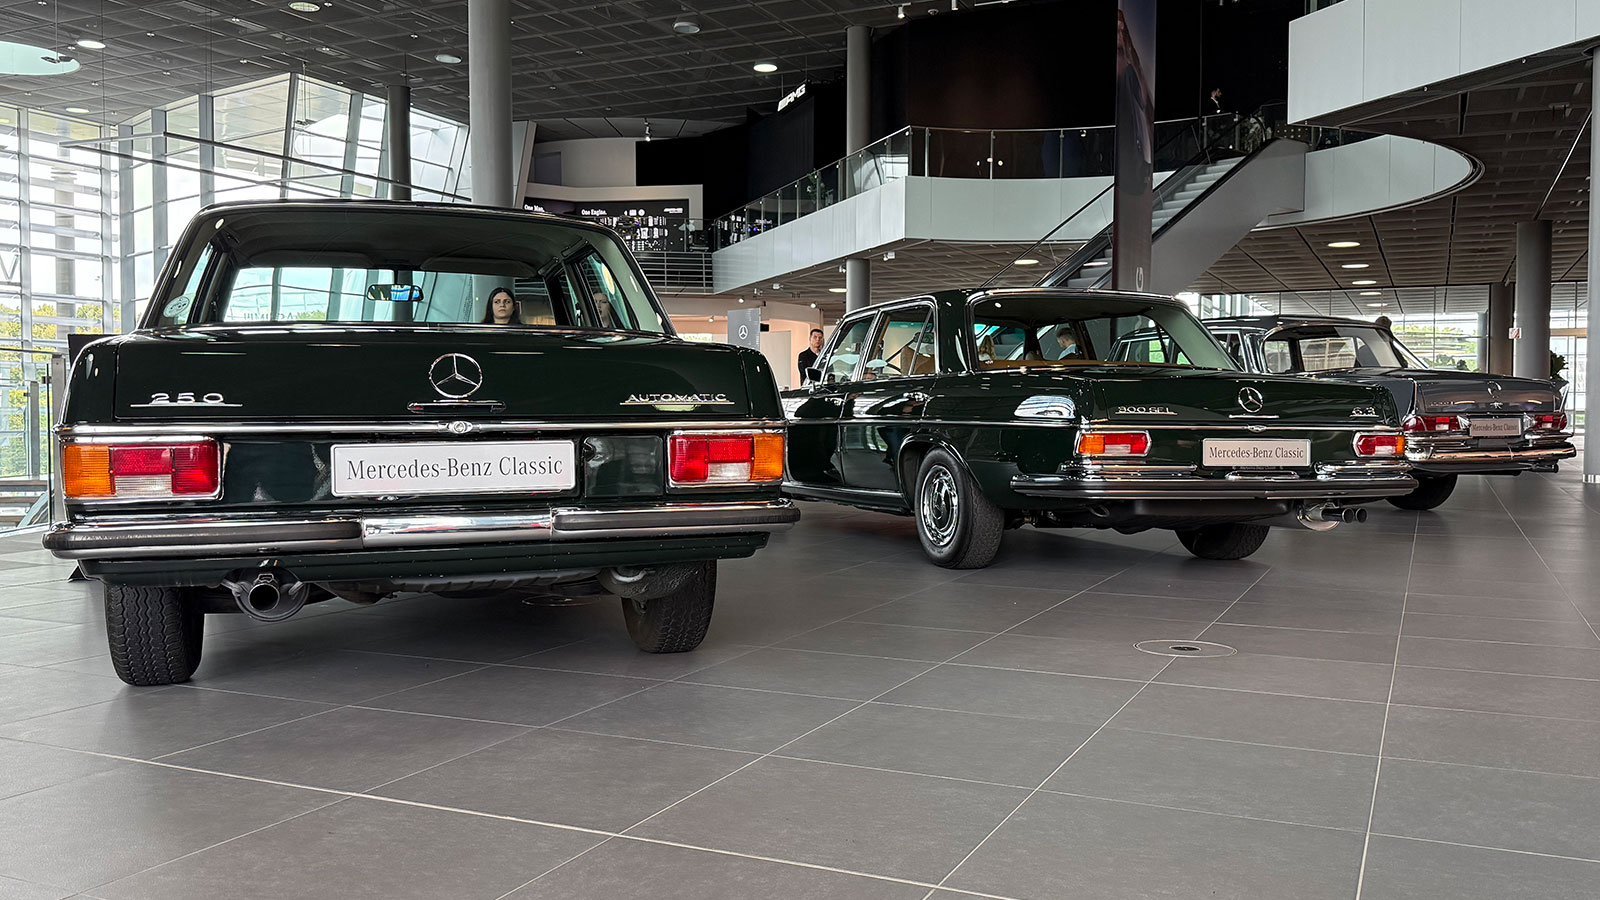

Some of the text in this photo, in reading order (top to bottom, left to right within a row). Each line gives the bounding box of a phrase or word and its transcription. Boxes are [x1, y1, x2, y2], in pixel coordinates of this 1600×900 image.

[151, 392, 224, 404] 250
[626, 393, 728, 403] AUTOMATIC
[1209, 446, 1304, 459] Mercedes-Benz Classic
[346, 455, 563, 480] Mercedes-Benz Classic
